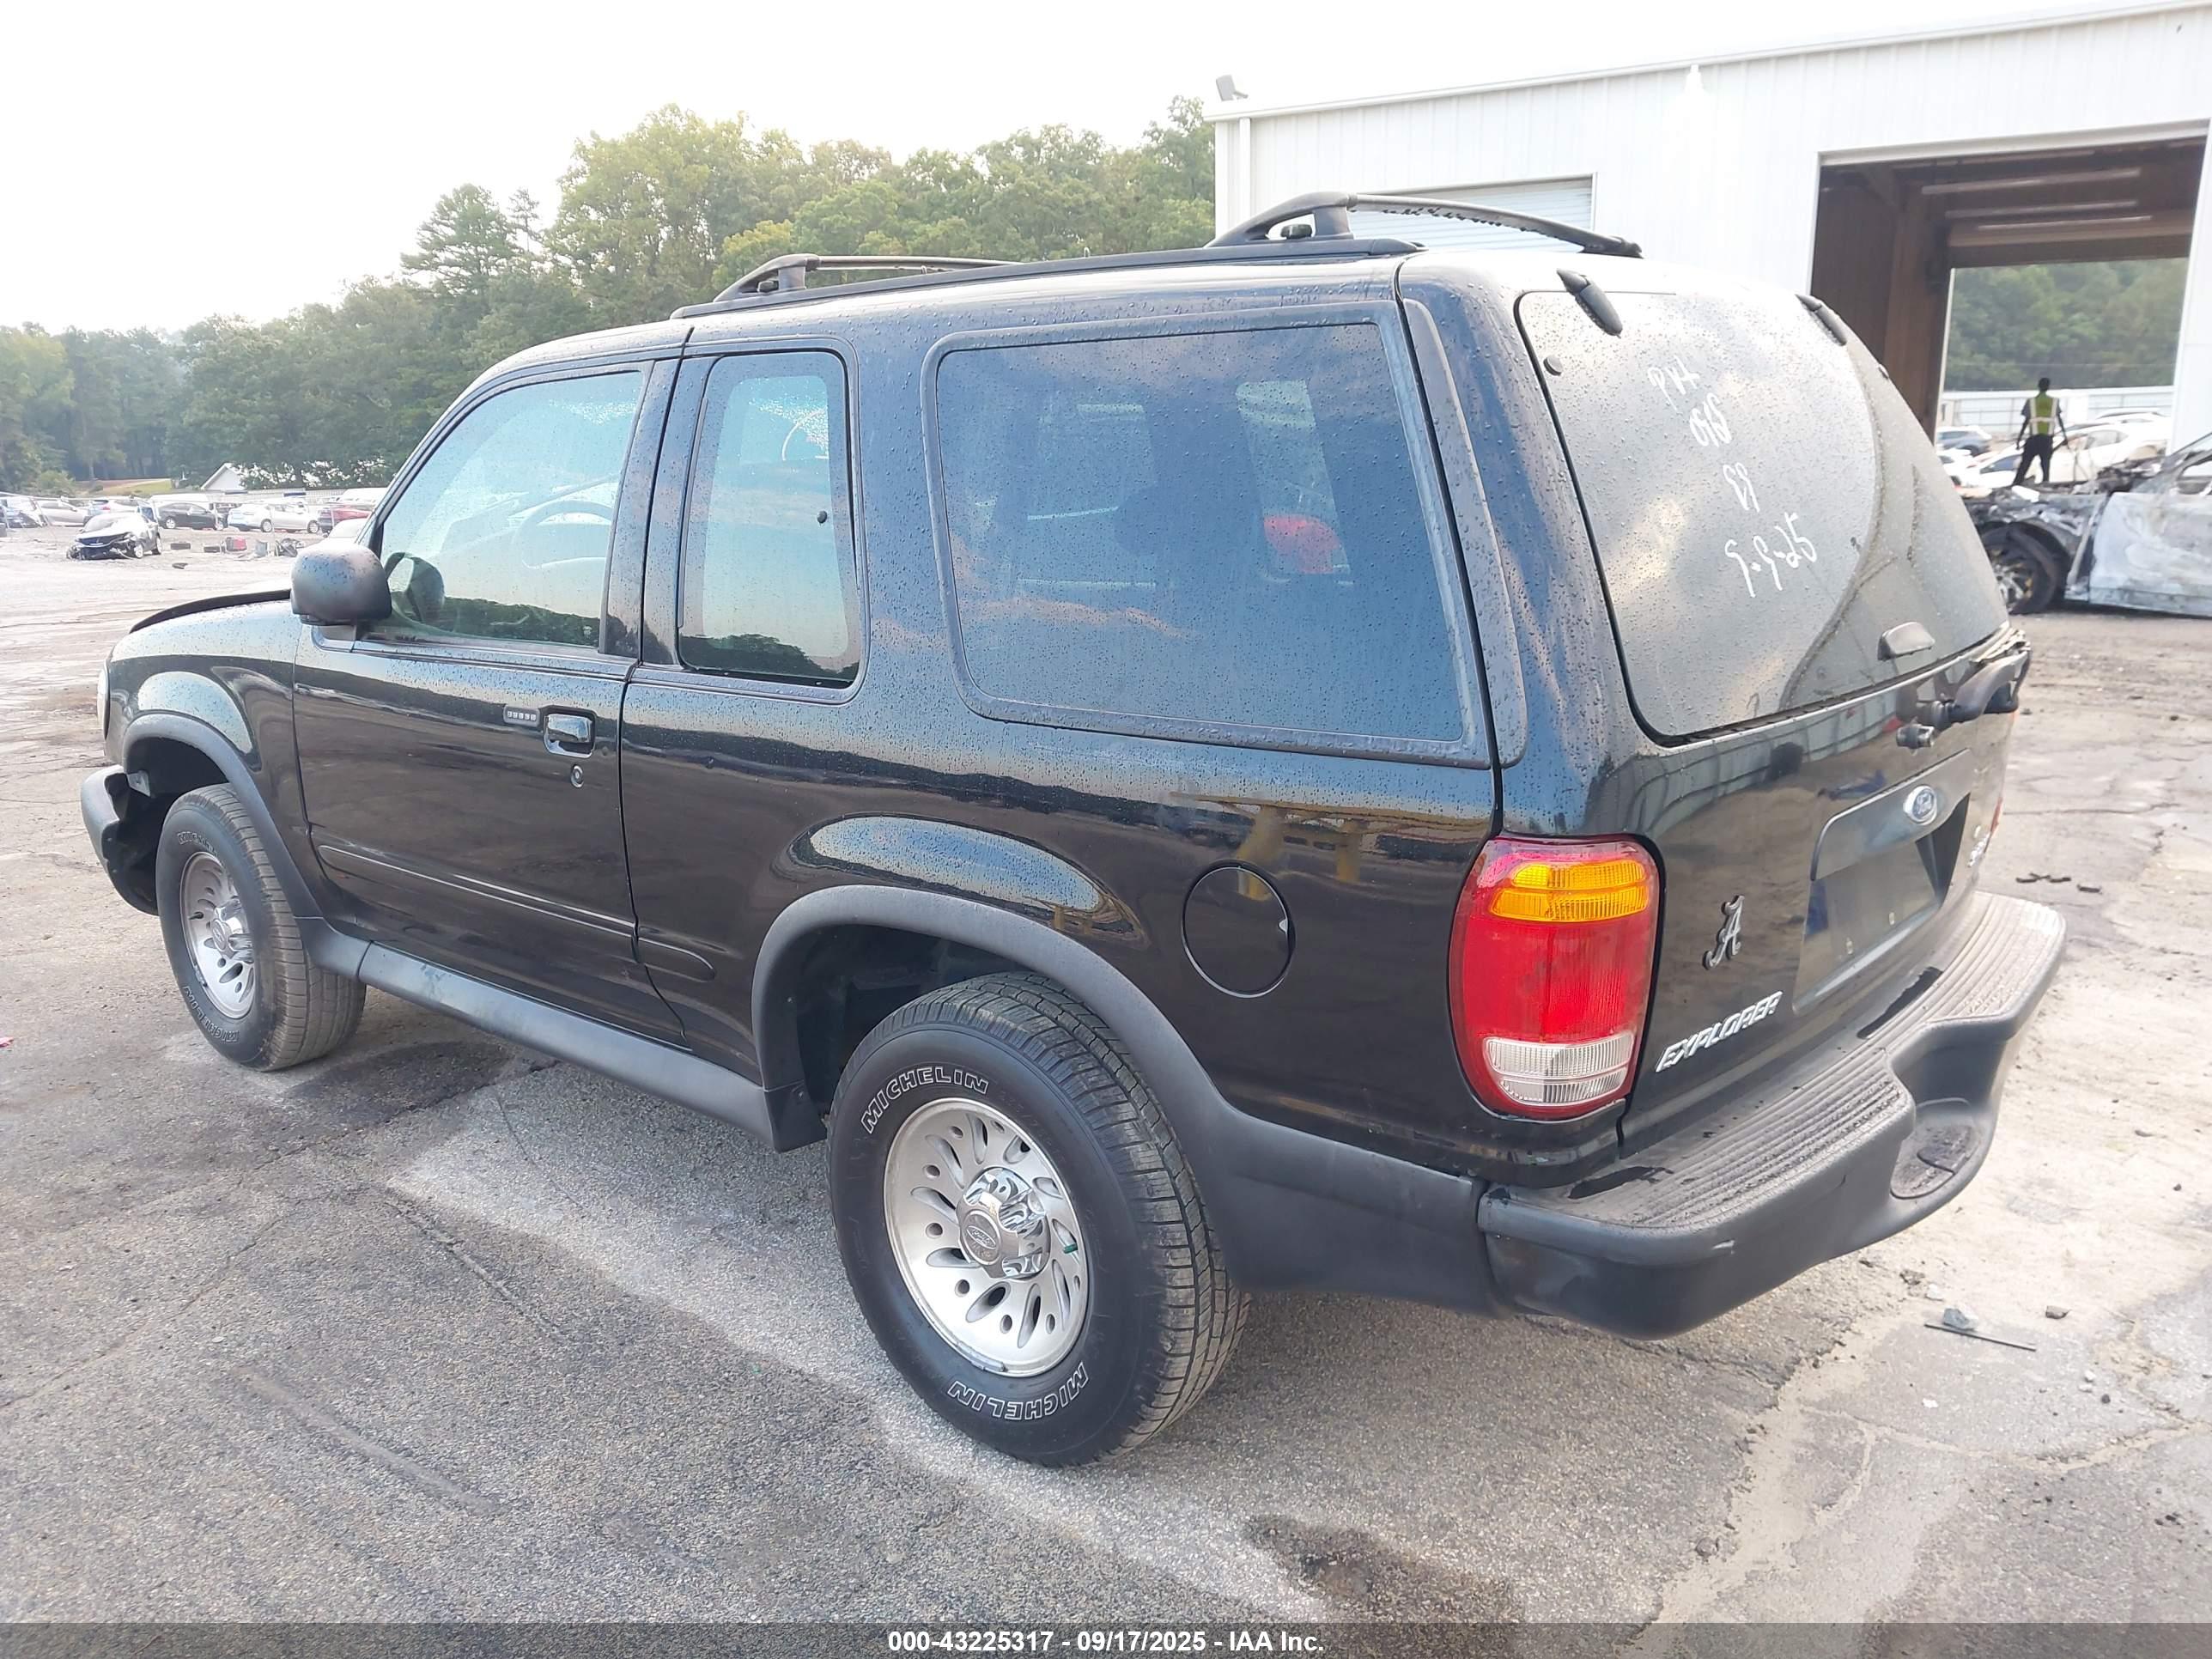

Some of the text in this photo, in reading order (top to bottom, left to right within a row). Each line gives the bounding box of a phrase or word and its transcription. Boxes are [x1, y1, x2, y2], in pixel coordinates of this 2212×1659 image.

[1655, 989, 1784, 1073] EXPLORER
[860, 1066, 989, 1134] MICHELIN
[947, 1361, 1089, 1420] MICHELIN
